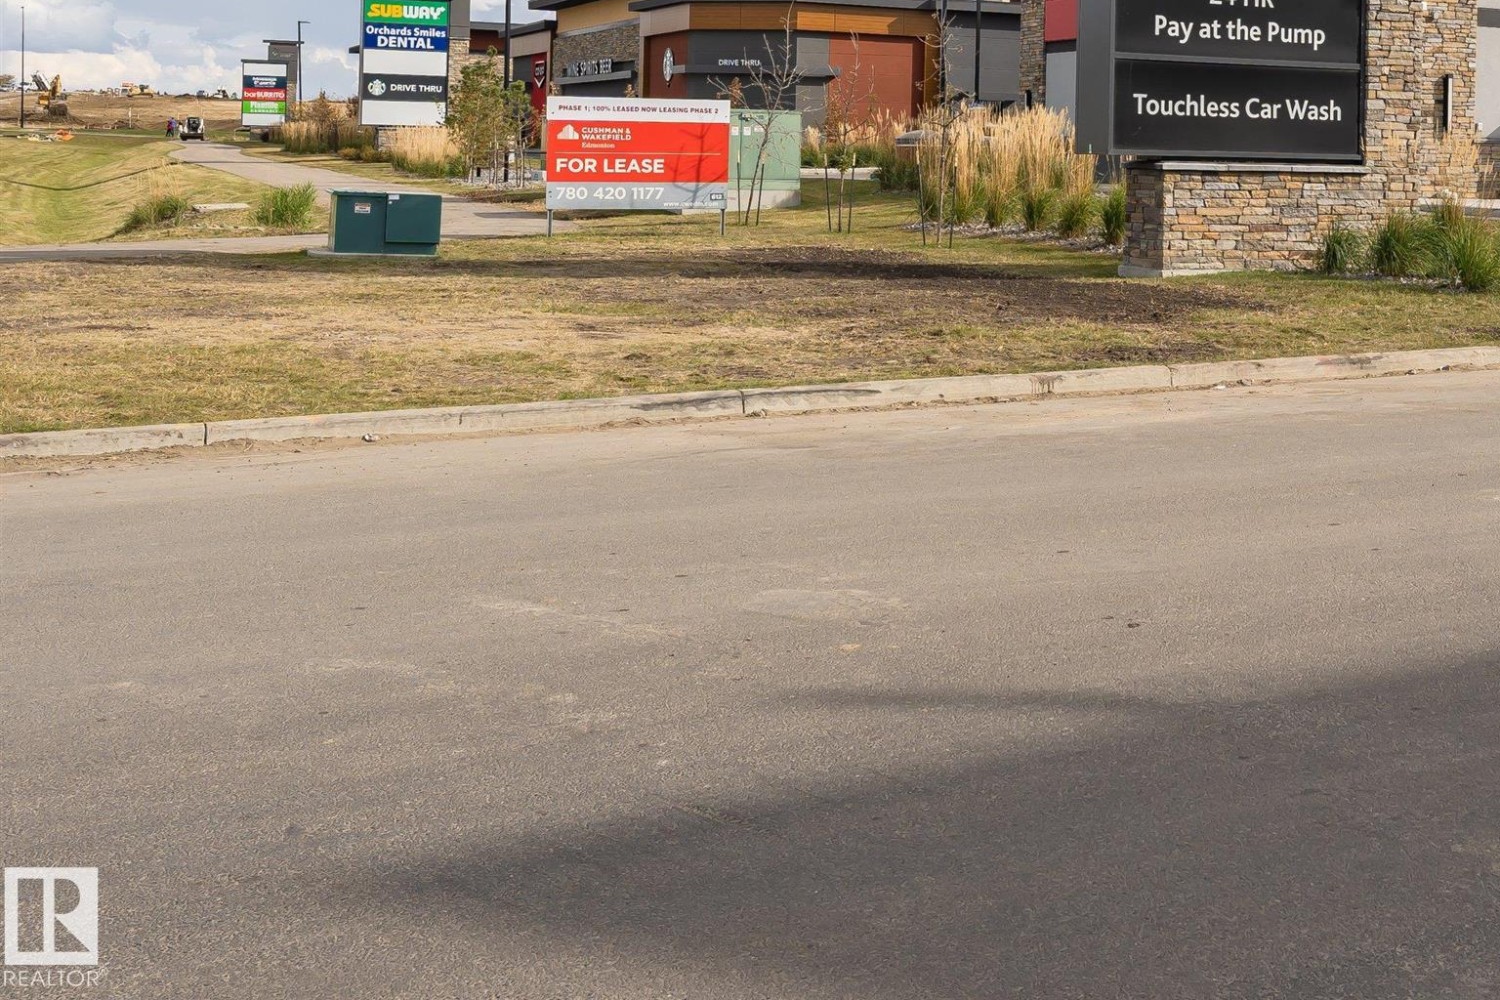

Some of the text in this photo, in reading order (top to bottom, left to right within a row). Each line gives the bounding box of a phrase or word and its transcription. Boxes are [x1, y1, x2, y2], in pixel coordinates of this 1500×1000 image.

[367, 3, 446, 20] SUBWAY
[366, 25, 446, 38] Orchards Smiles
[1154, 14, 1326, 51] Pay at the Pump
[377, 36, 435, 49] DENTAL
[390, 83, 443, 93] DRIVE THRU
[1133, 93, 1342, 121] Touchless Car Wash
[581, 141, 615, 149] Edmonton
[555, 158, 665, 174] FOR LEASE
[555, 187, 665, 201] 780 420 1177
